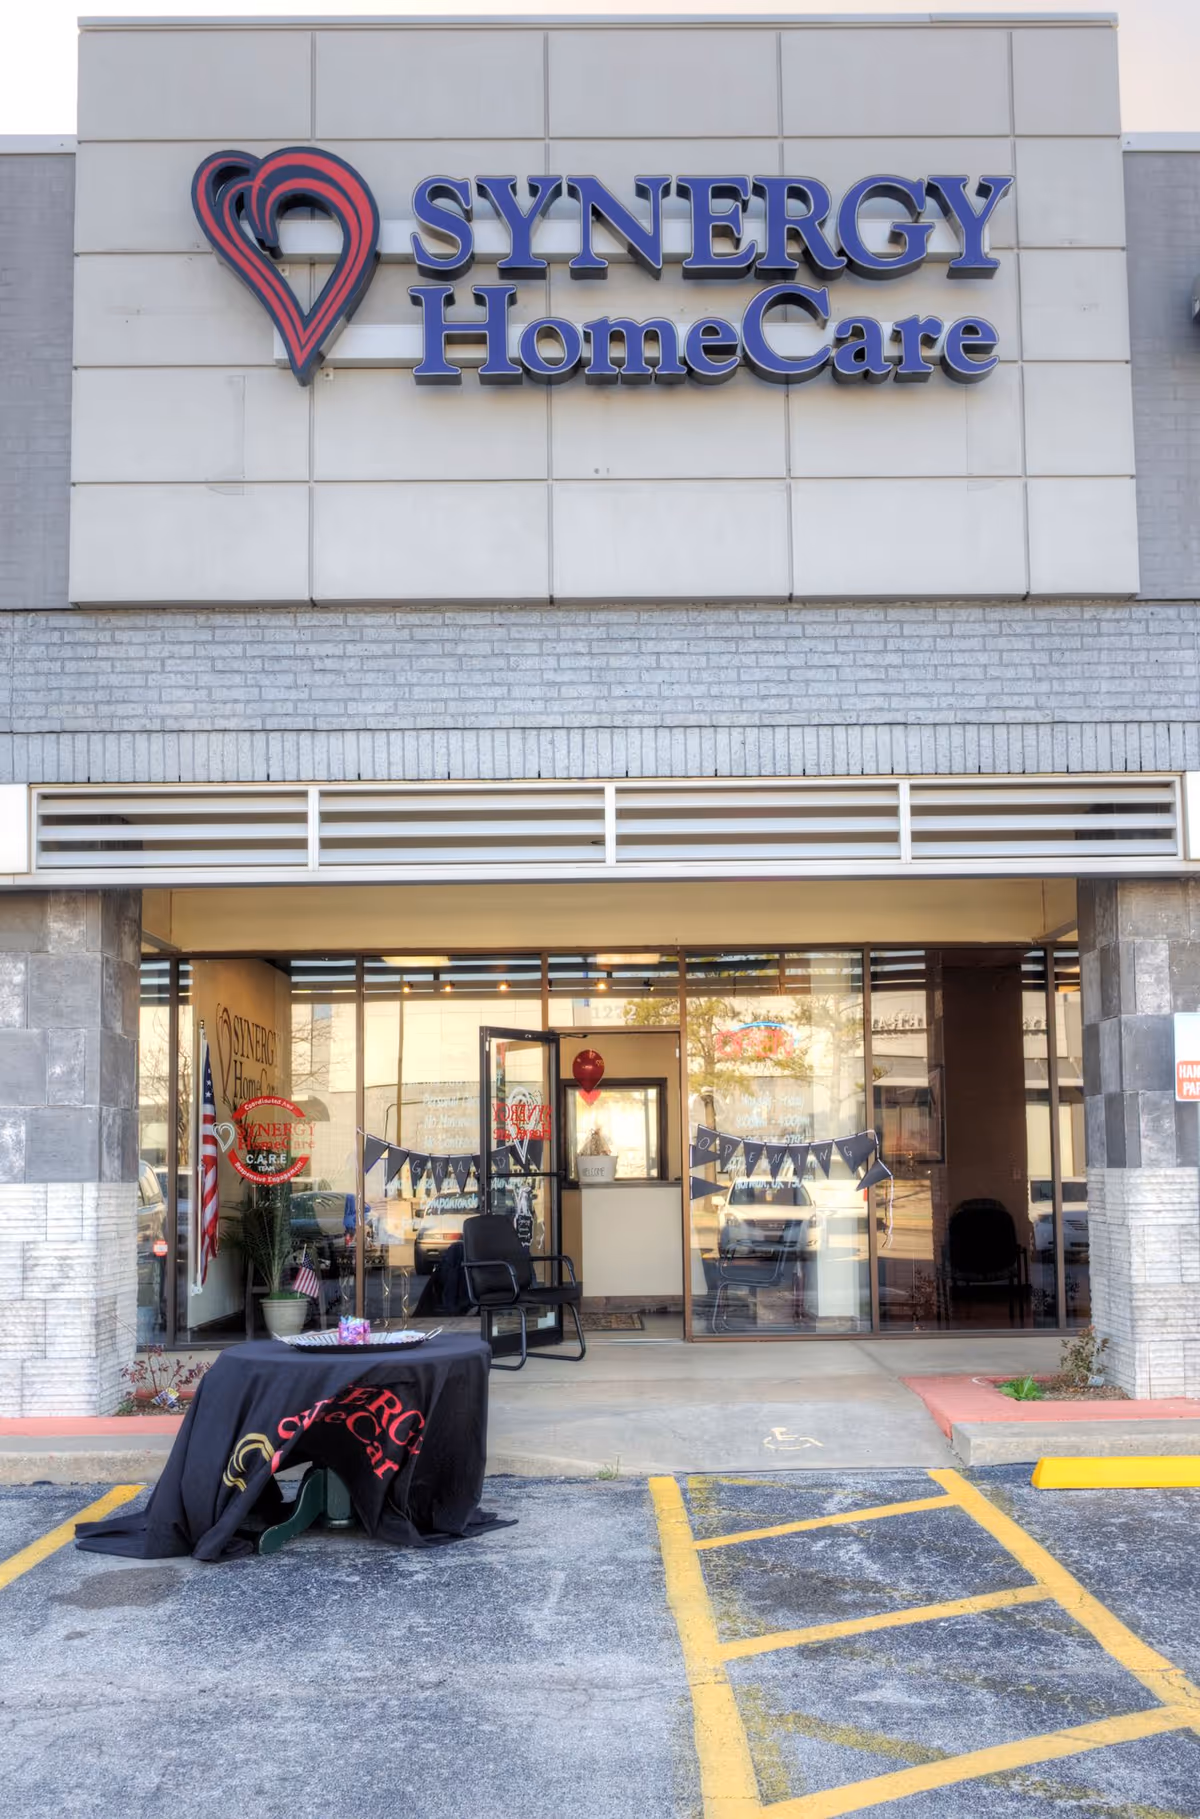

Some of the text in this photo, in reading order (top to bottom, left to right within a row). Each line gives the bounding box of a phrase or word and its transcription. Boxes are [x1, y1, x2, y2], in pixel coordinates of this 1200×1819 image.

[410, 175, 1015, 277] SYNERGY
[407, 283, 1000, 381] HomeCare
[591, 1005, 637, 1020] 1272
[234, 1122, 315, 1137] SYNERGY
[411, 1156, 506, 1178] GRAD
